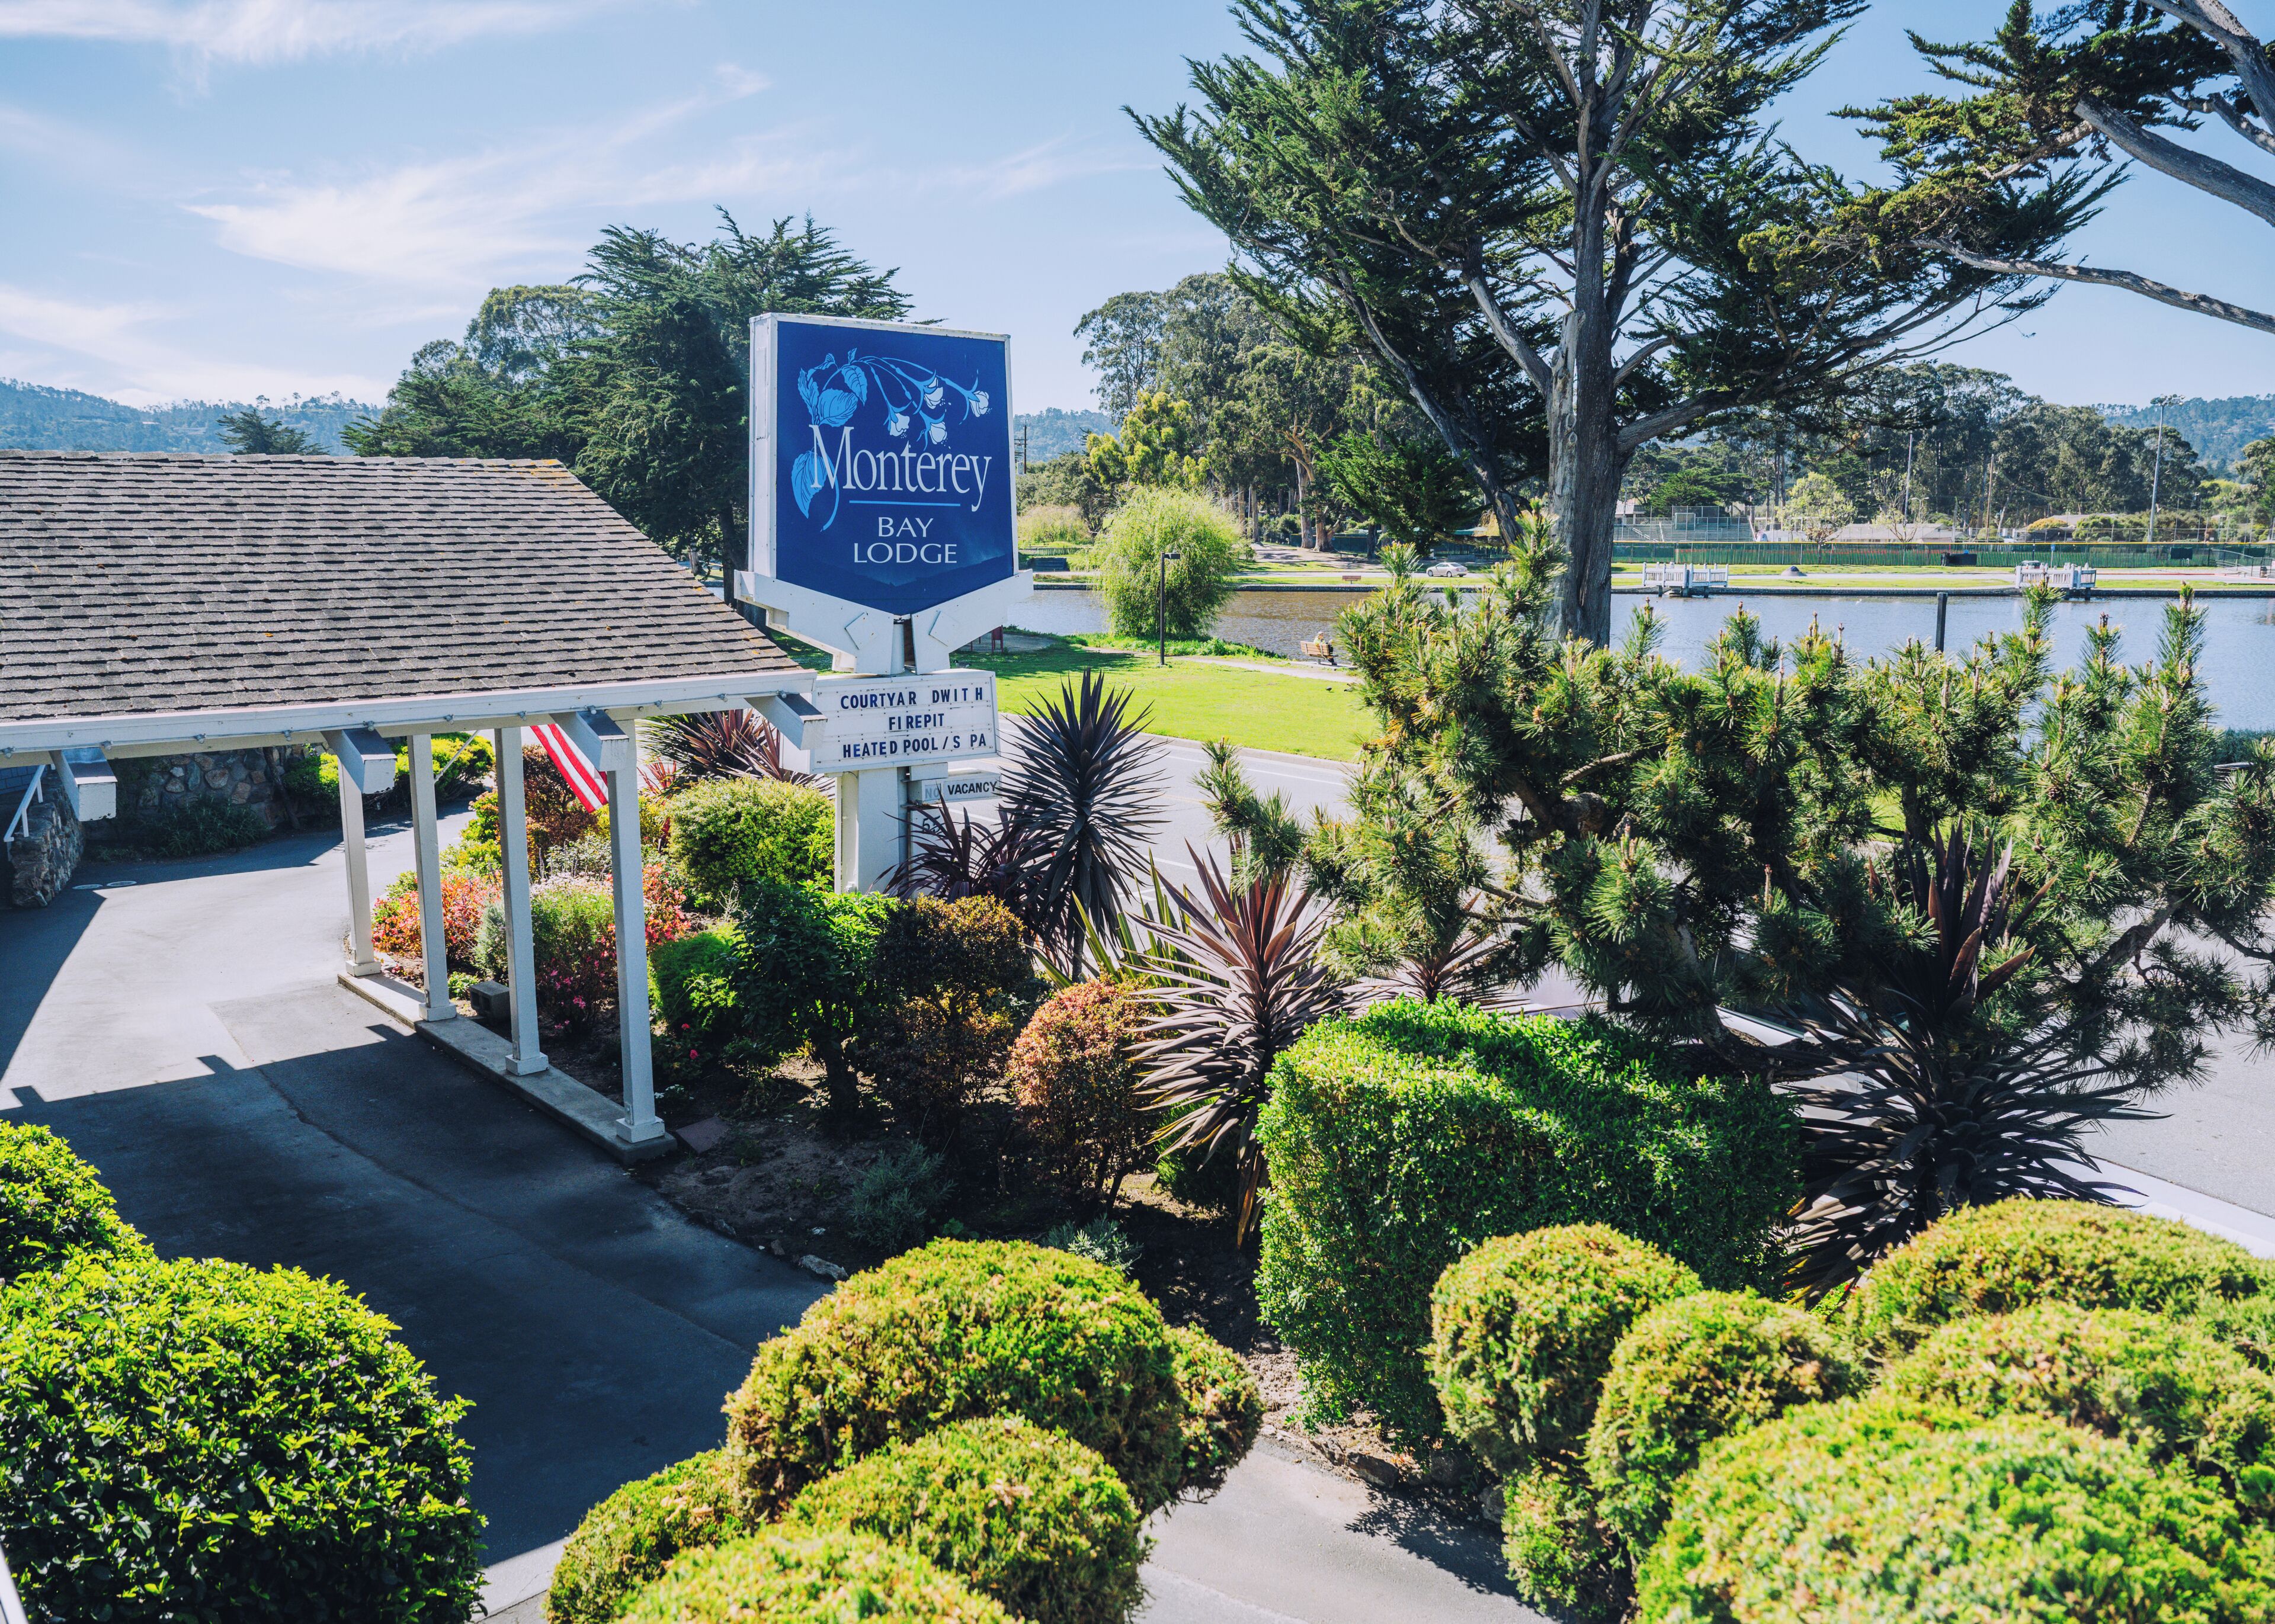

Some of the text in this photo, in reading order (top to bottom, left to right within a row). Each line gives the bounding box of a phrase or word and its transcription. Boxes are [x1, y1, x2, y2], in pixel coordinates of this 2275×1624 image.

[809, 425, 992, 512] Monterey
[878, 516, 934, 538] BAY
[854, 543, 957, 564] LODGE
[842, 740, 898, 758] HEATED
[947, 781, 998, 795] VACANCY
